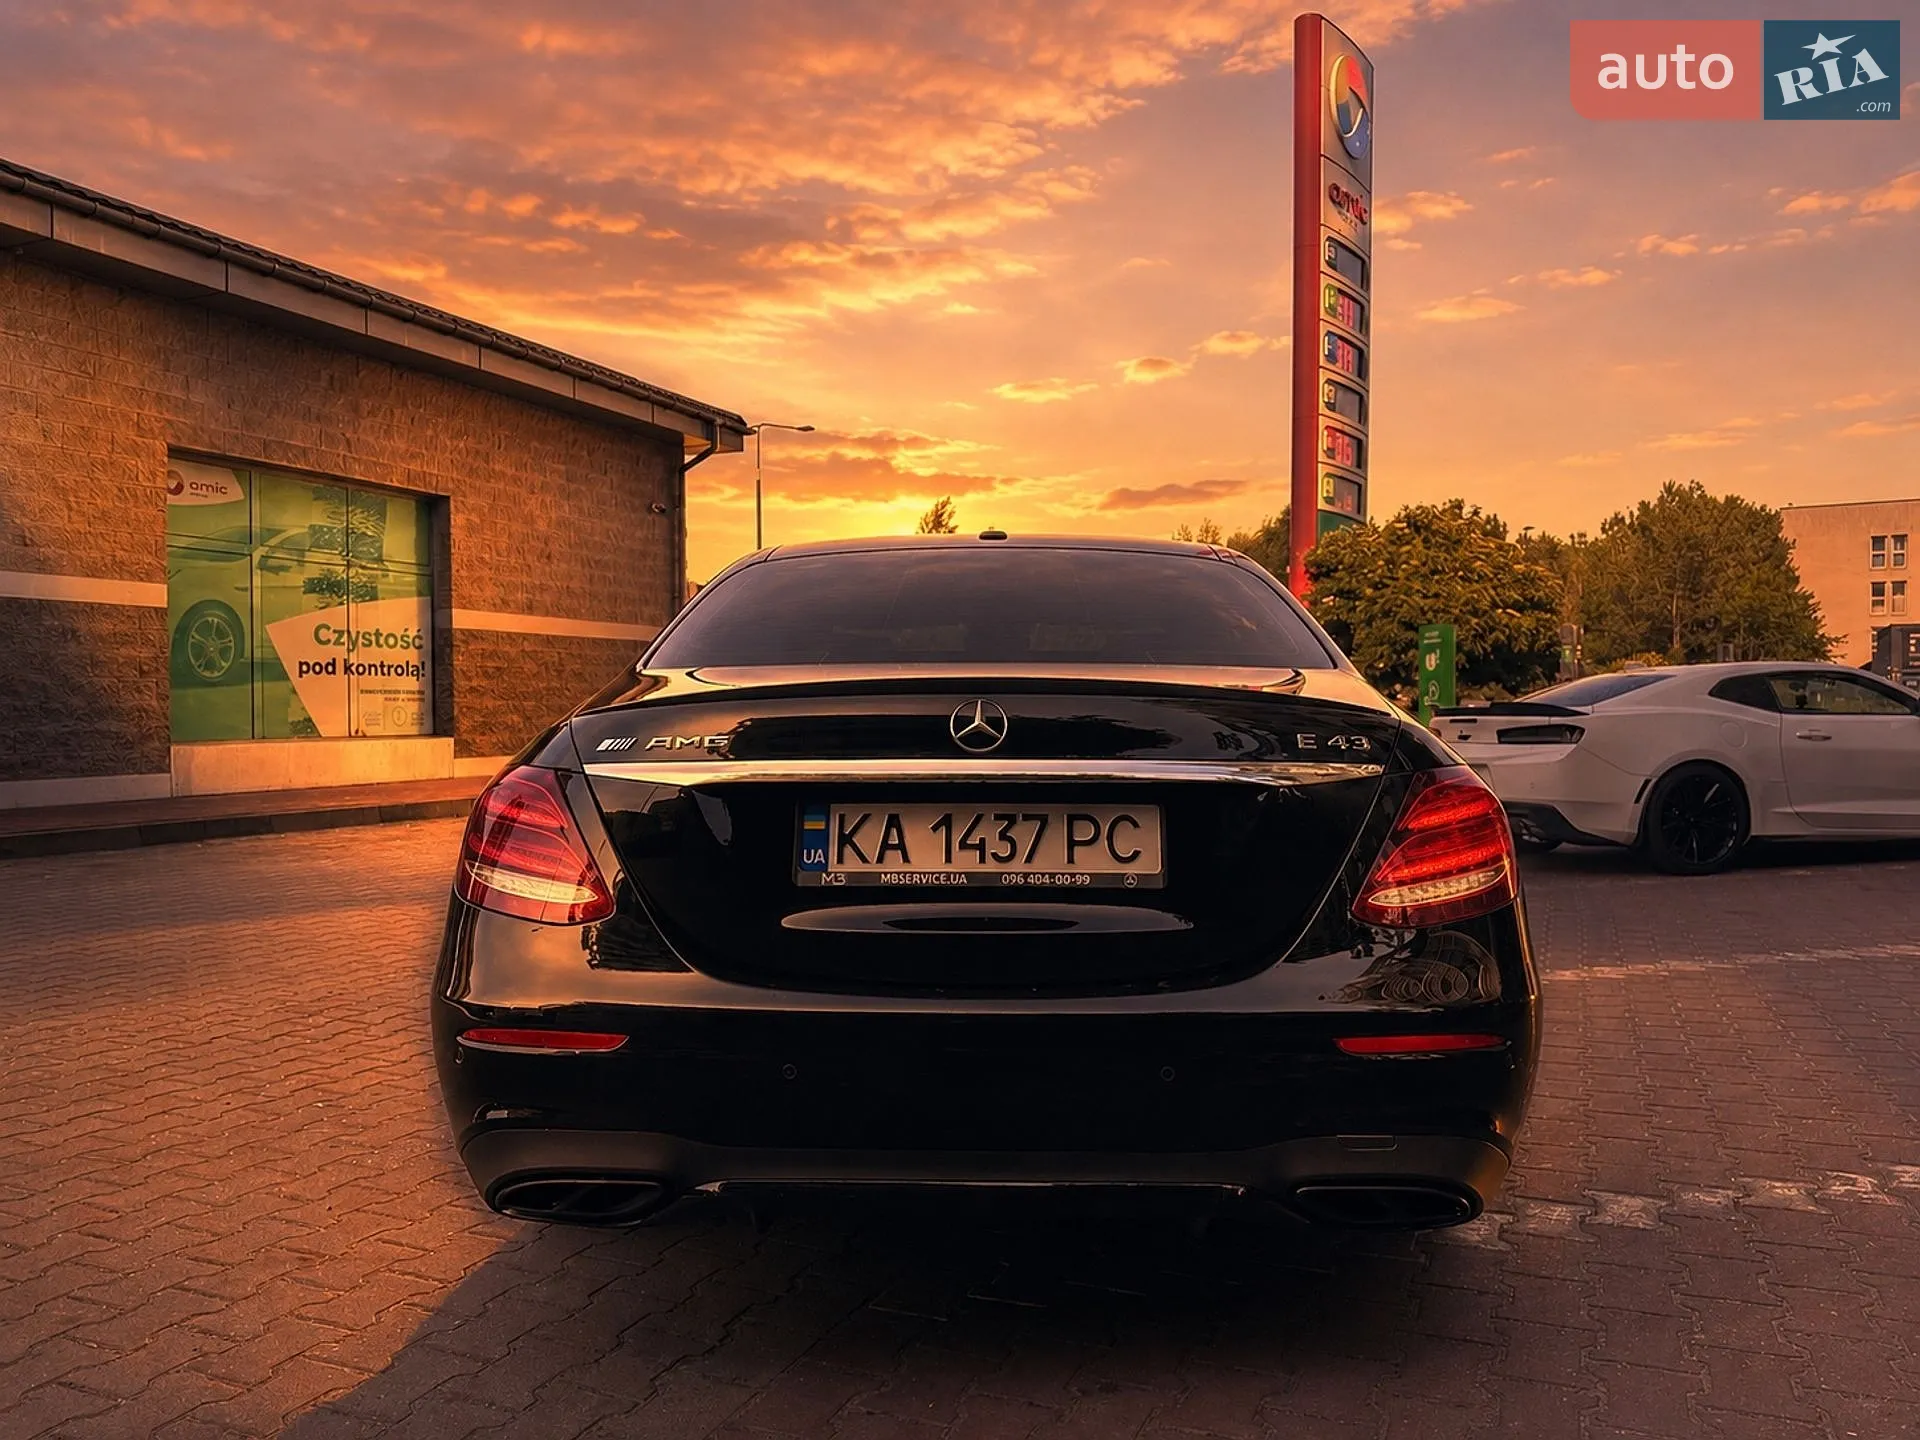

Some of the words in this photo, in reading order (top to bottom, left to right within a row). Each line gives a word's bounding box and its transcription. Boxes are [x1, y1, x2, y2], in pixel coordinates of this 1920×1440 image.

[189, 480, 229, 495] amic
[313, 623, 424, 653] Czystość
[298, 657, 337, 678] pod
[343, 658, 426, 682] kontrolą!
[644, 734, 730, 750] AMG
[1296, 733, 1318, 750] E
[1327, 734, 1371, 750] 43
[835, 812, 911, 865] KA
[928, 812, 1049, 865] 1437
[1064, 812, 1143, 865] PC
[803, 848, 826, 865] UA
[880, 872, 968, 885] MBSERVICE.UA
[1001, 873, 1024, 885] 096
